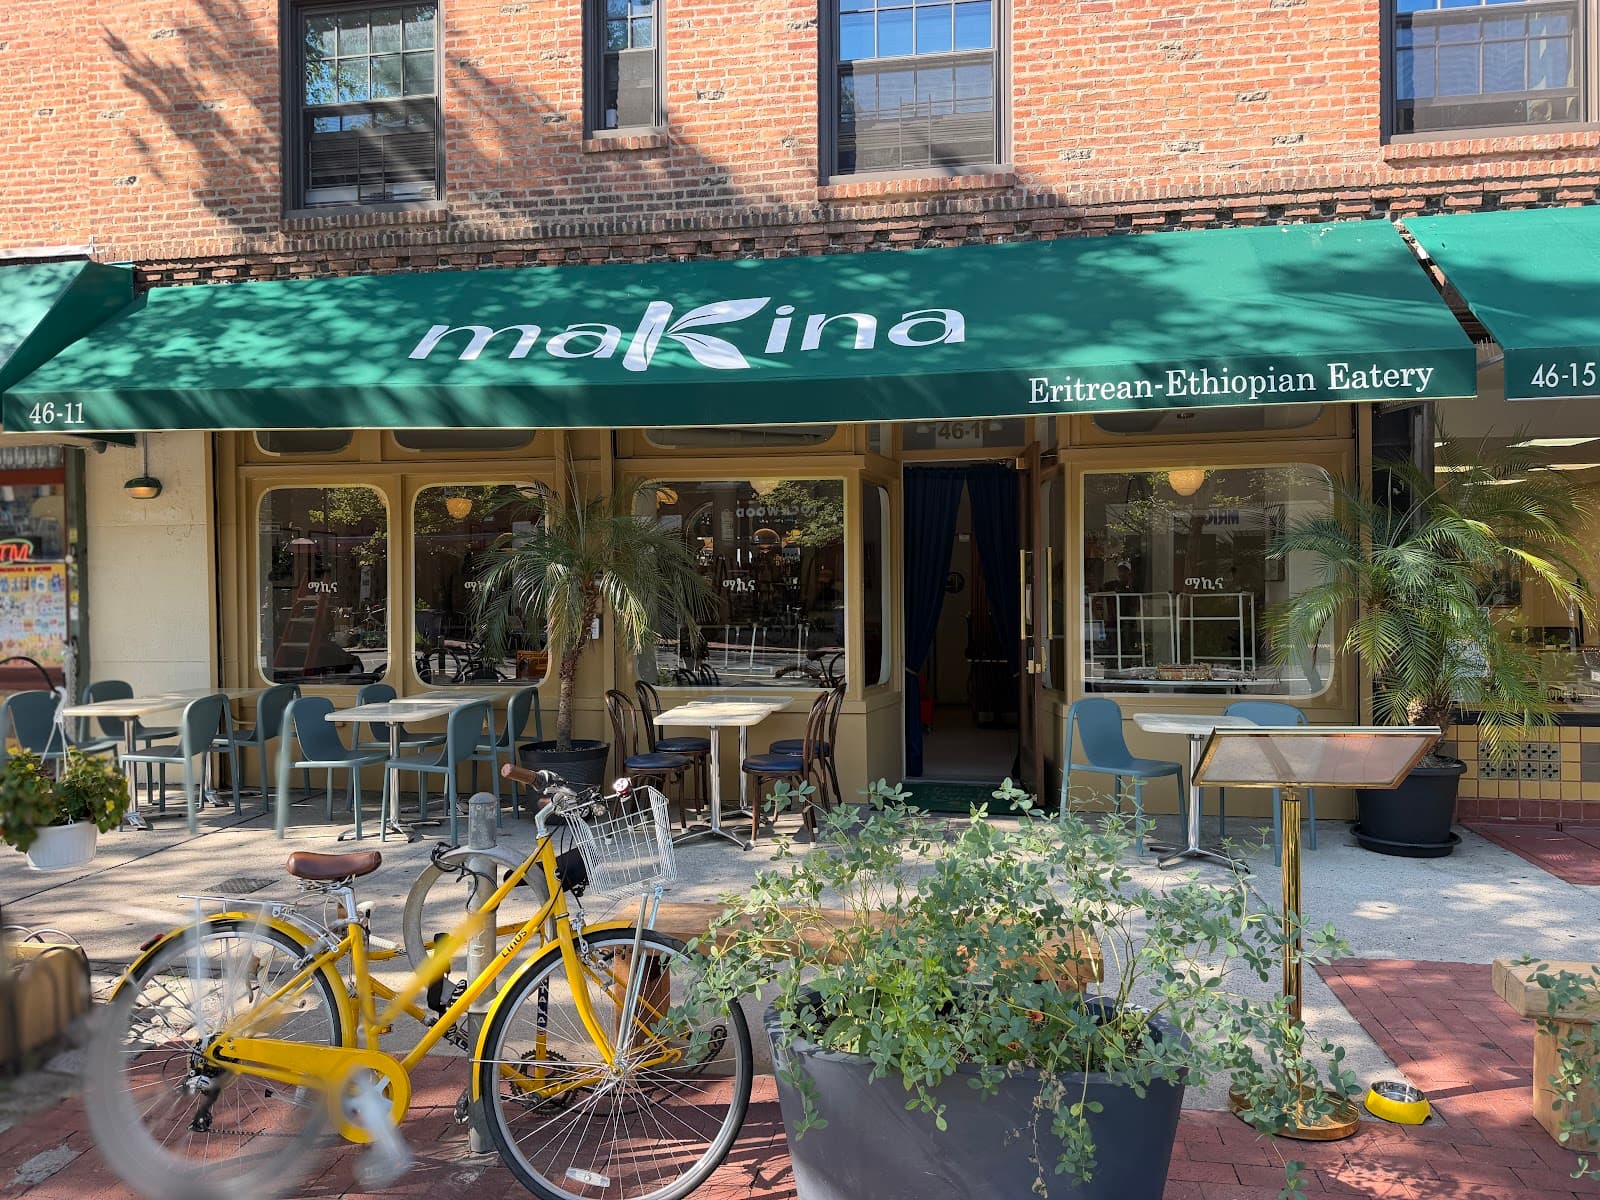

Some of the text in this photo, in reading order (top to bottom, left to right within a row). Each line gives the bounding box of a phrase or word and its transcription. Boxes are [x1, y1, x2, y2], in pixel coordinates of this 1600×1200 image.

[1029, 362, 1434, 404] Eritrean-Ethiopian Eatery
[1530, 361, 1597, 388] 46-15
[29, 401, 85, 424] 46-11
